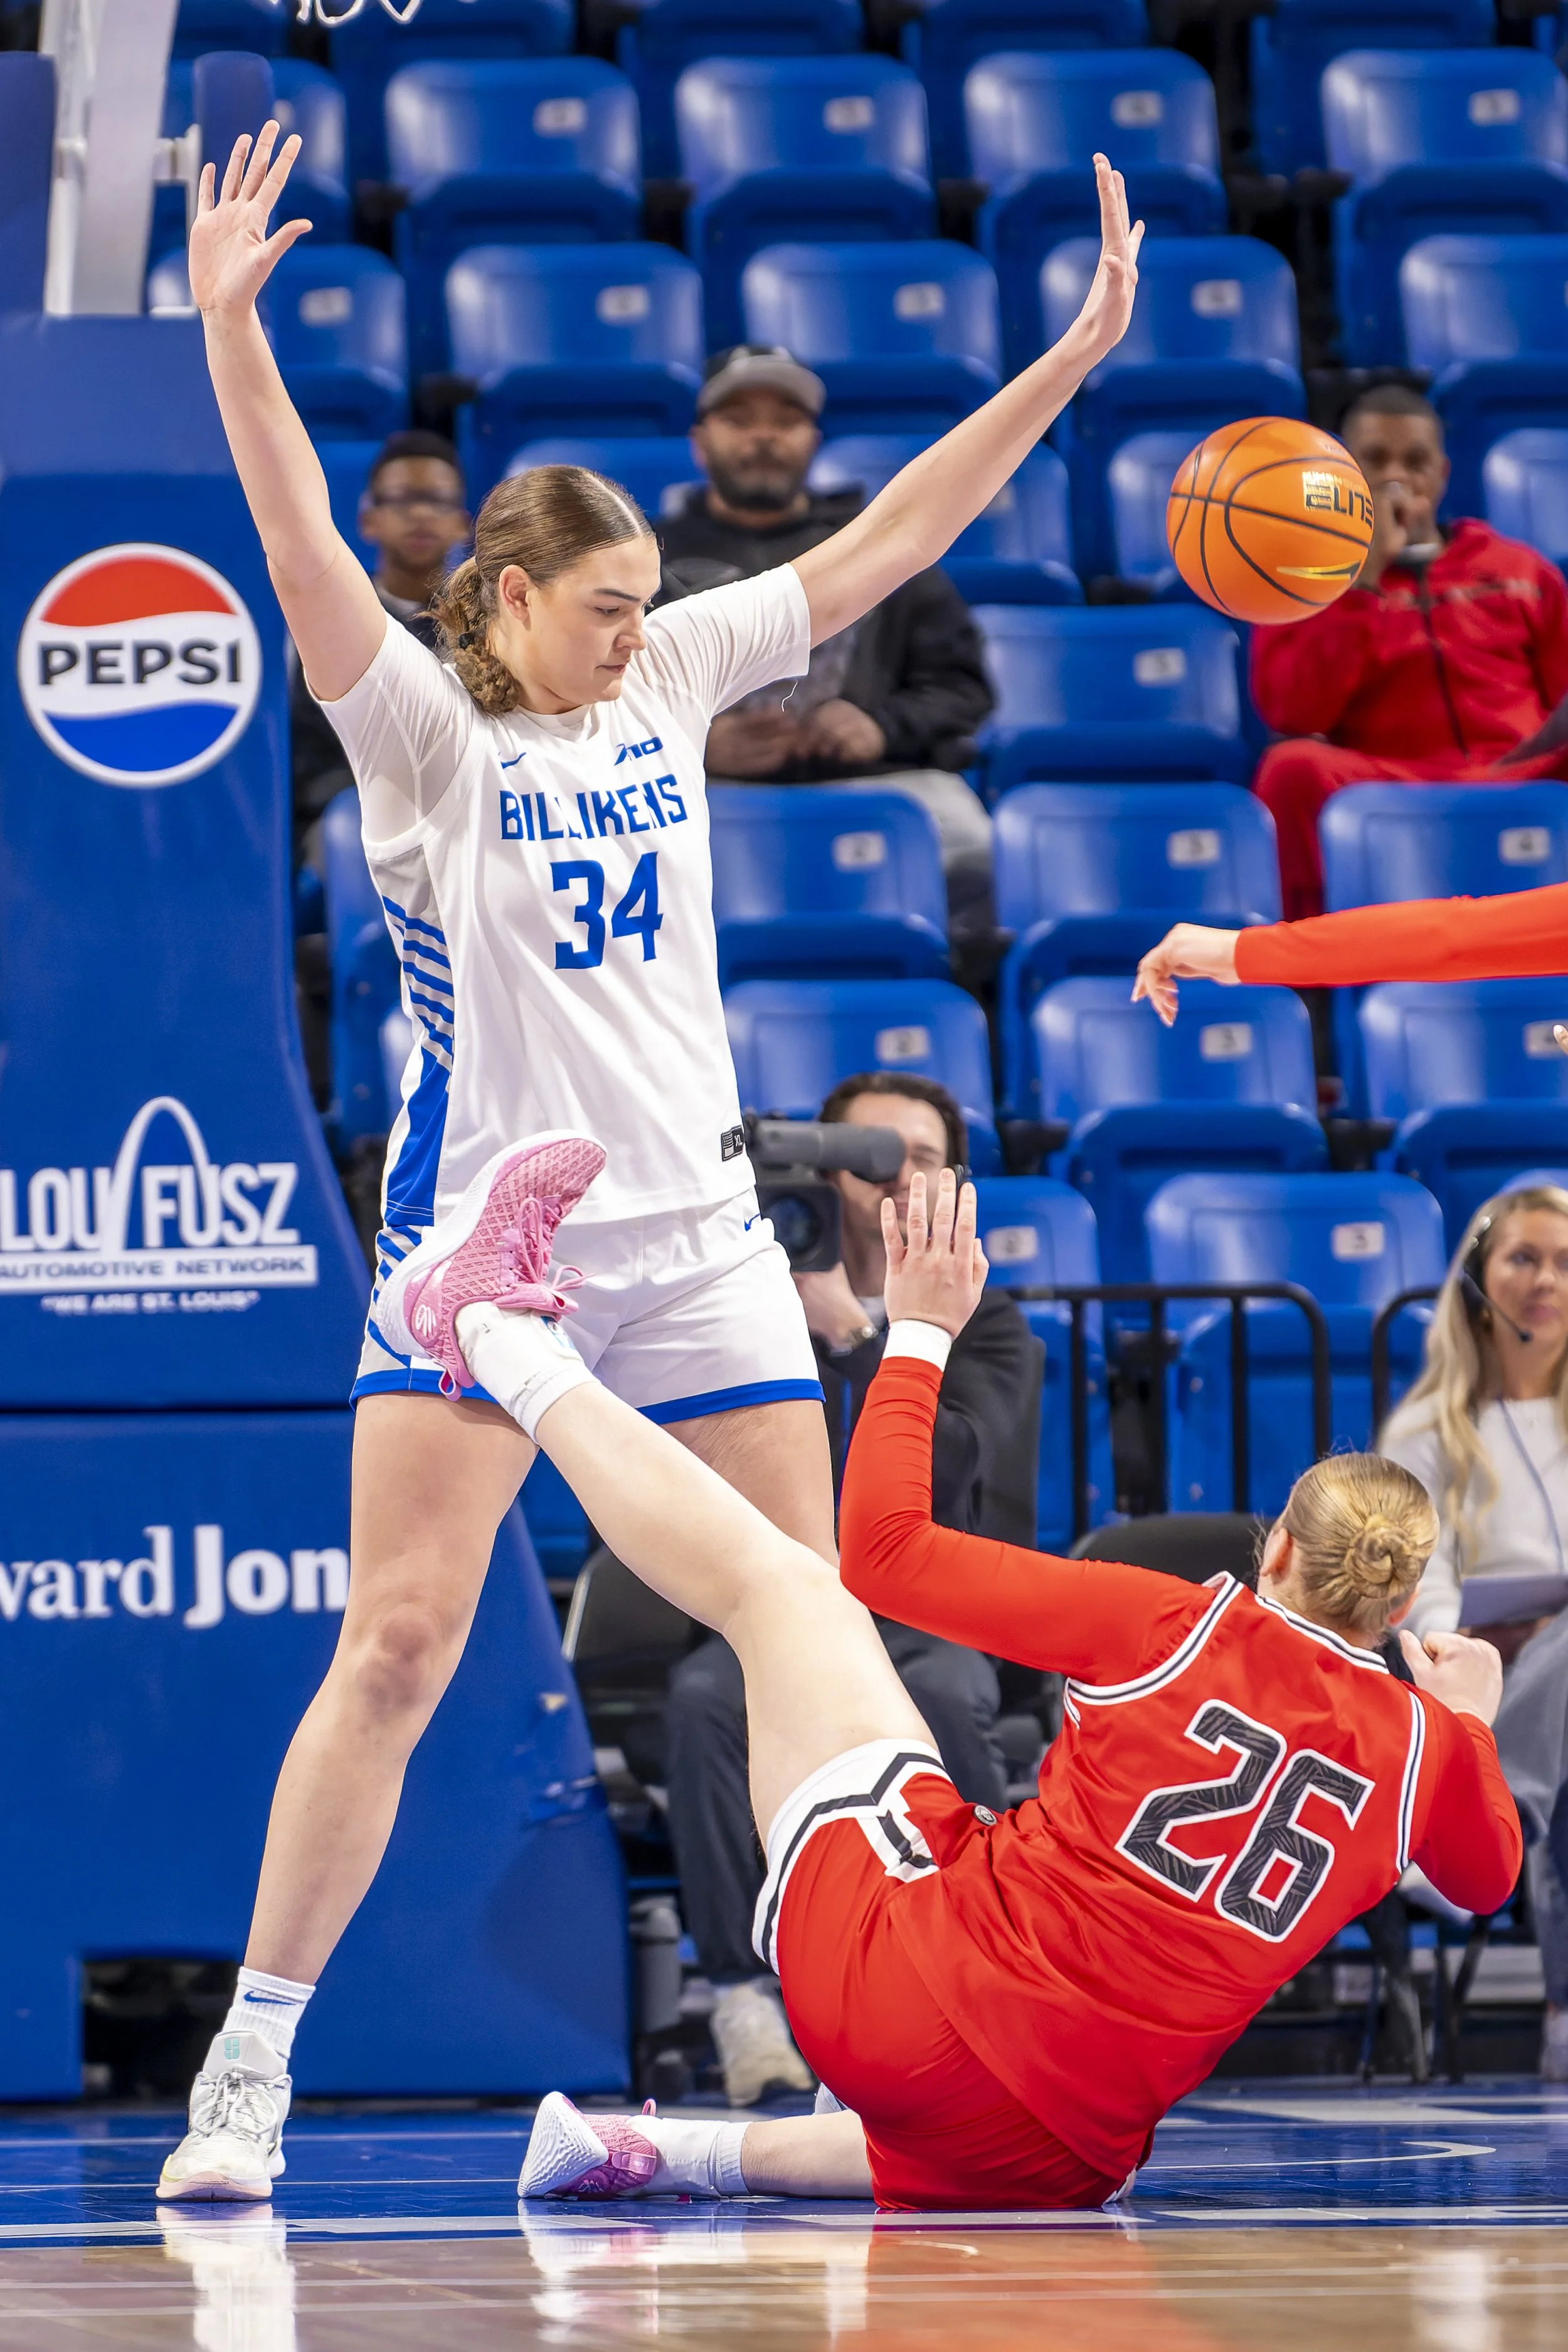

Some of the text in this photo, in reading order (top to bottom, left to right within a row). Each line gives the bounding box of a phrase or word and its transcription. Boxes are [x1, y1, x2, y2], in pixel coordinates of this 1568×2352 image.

[38, 638, 242, 685] PEPSI
[549, 851, 663, 970] 34
[734, 1134, 743, 1147] XL
[0, 1162, 300, 1252] LOU FUSZ
[0, 1256, 305, 1279] AUTOMOTIVE NETWORK
[91, 1293, 137, 1315] ARE
[184, 1524, 351, 1629] Jon
[1114, 1698, 1375, 1943] 26
